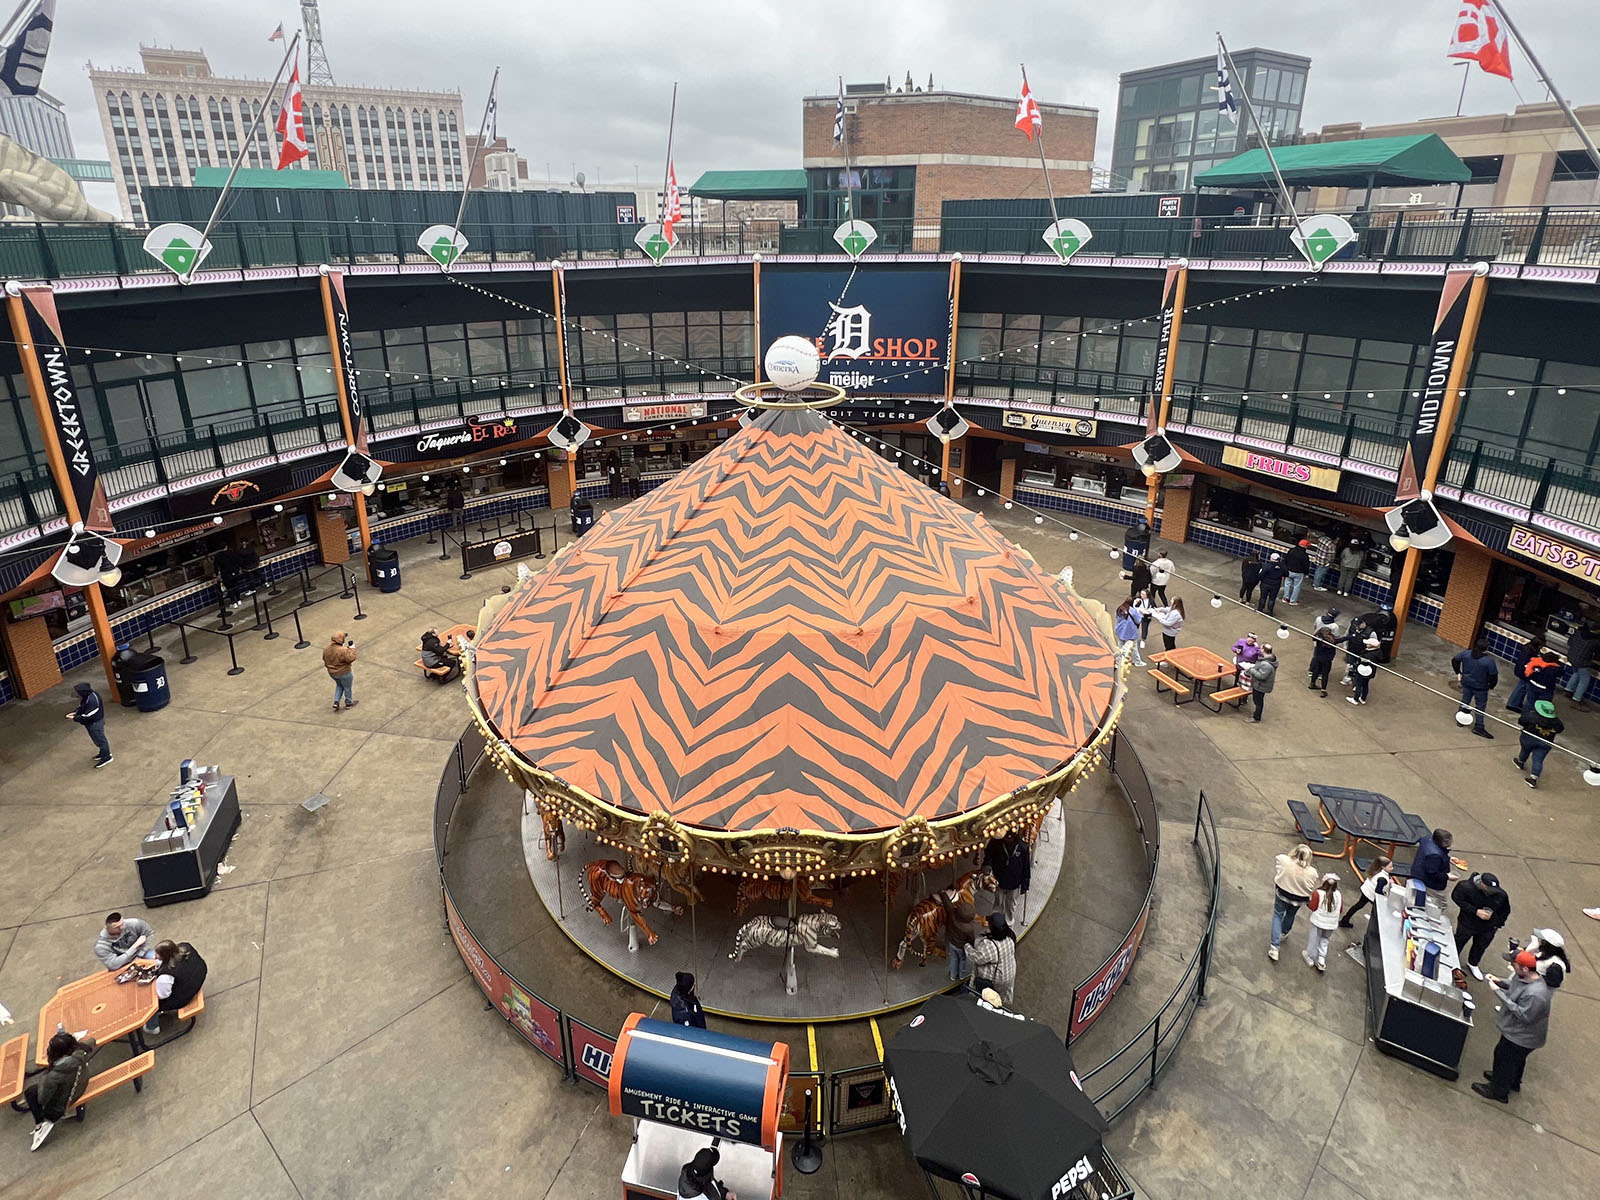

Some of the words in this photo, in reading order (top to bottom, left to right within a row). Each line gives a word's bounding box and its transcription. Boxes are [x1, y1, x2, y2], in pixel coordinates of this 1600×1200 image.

[338, 312, 360, 416] CORKTOWN
[873, 337, 938, 358] SHOP
[1154, 347, 1168, 392] STATE
[1161, 307, 1174, 342] FAIR
[829, 371, 875, 388] meijer
[1416, 340, 1455, 434] MIDTOWN
[43, 353, 91, 477] GREEKTOWN
[644, 405, 688, 416] NATIONAL
[863, 411, 915, 420] TIGERS
[1245, 452, 1311, 482] FRIES
[624, 1087, 662, 1101] AMUSEMENT
[665, 1096, 681, 1106] RIDE
[693, 1102, 736, 1118] INTERACTIVE
[738, 1113, 758, 1123] GAME
[640, 1099, 740, 1136] TICKETS
[1051, 1154, 1094, 1200] PEPSI
